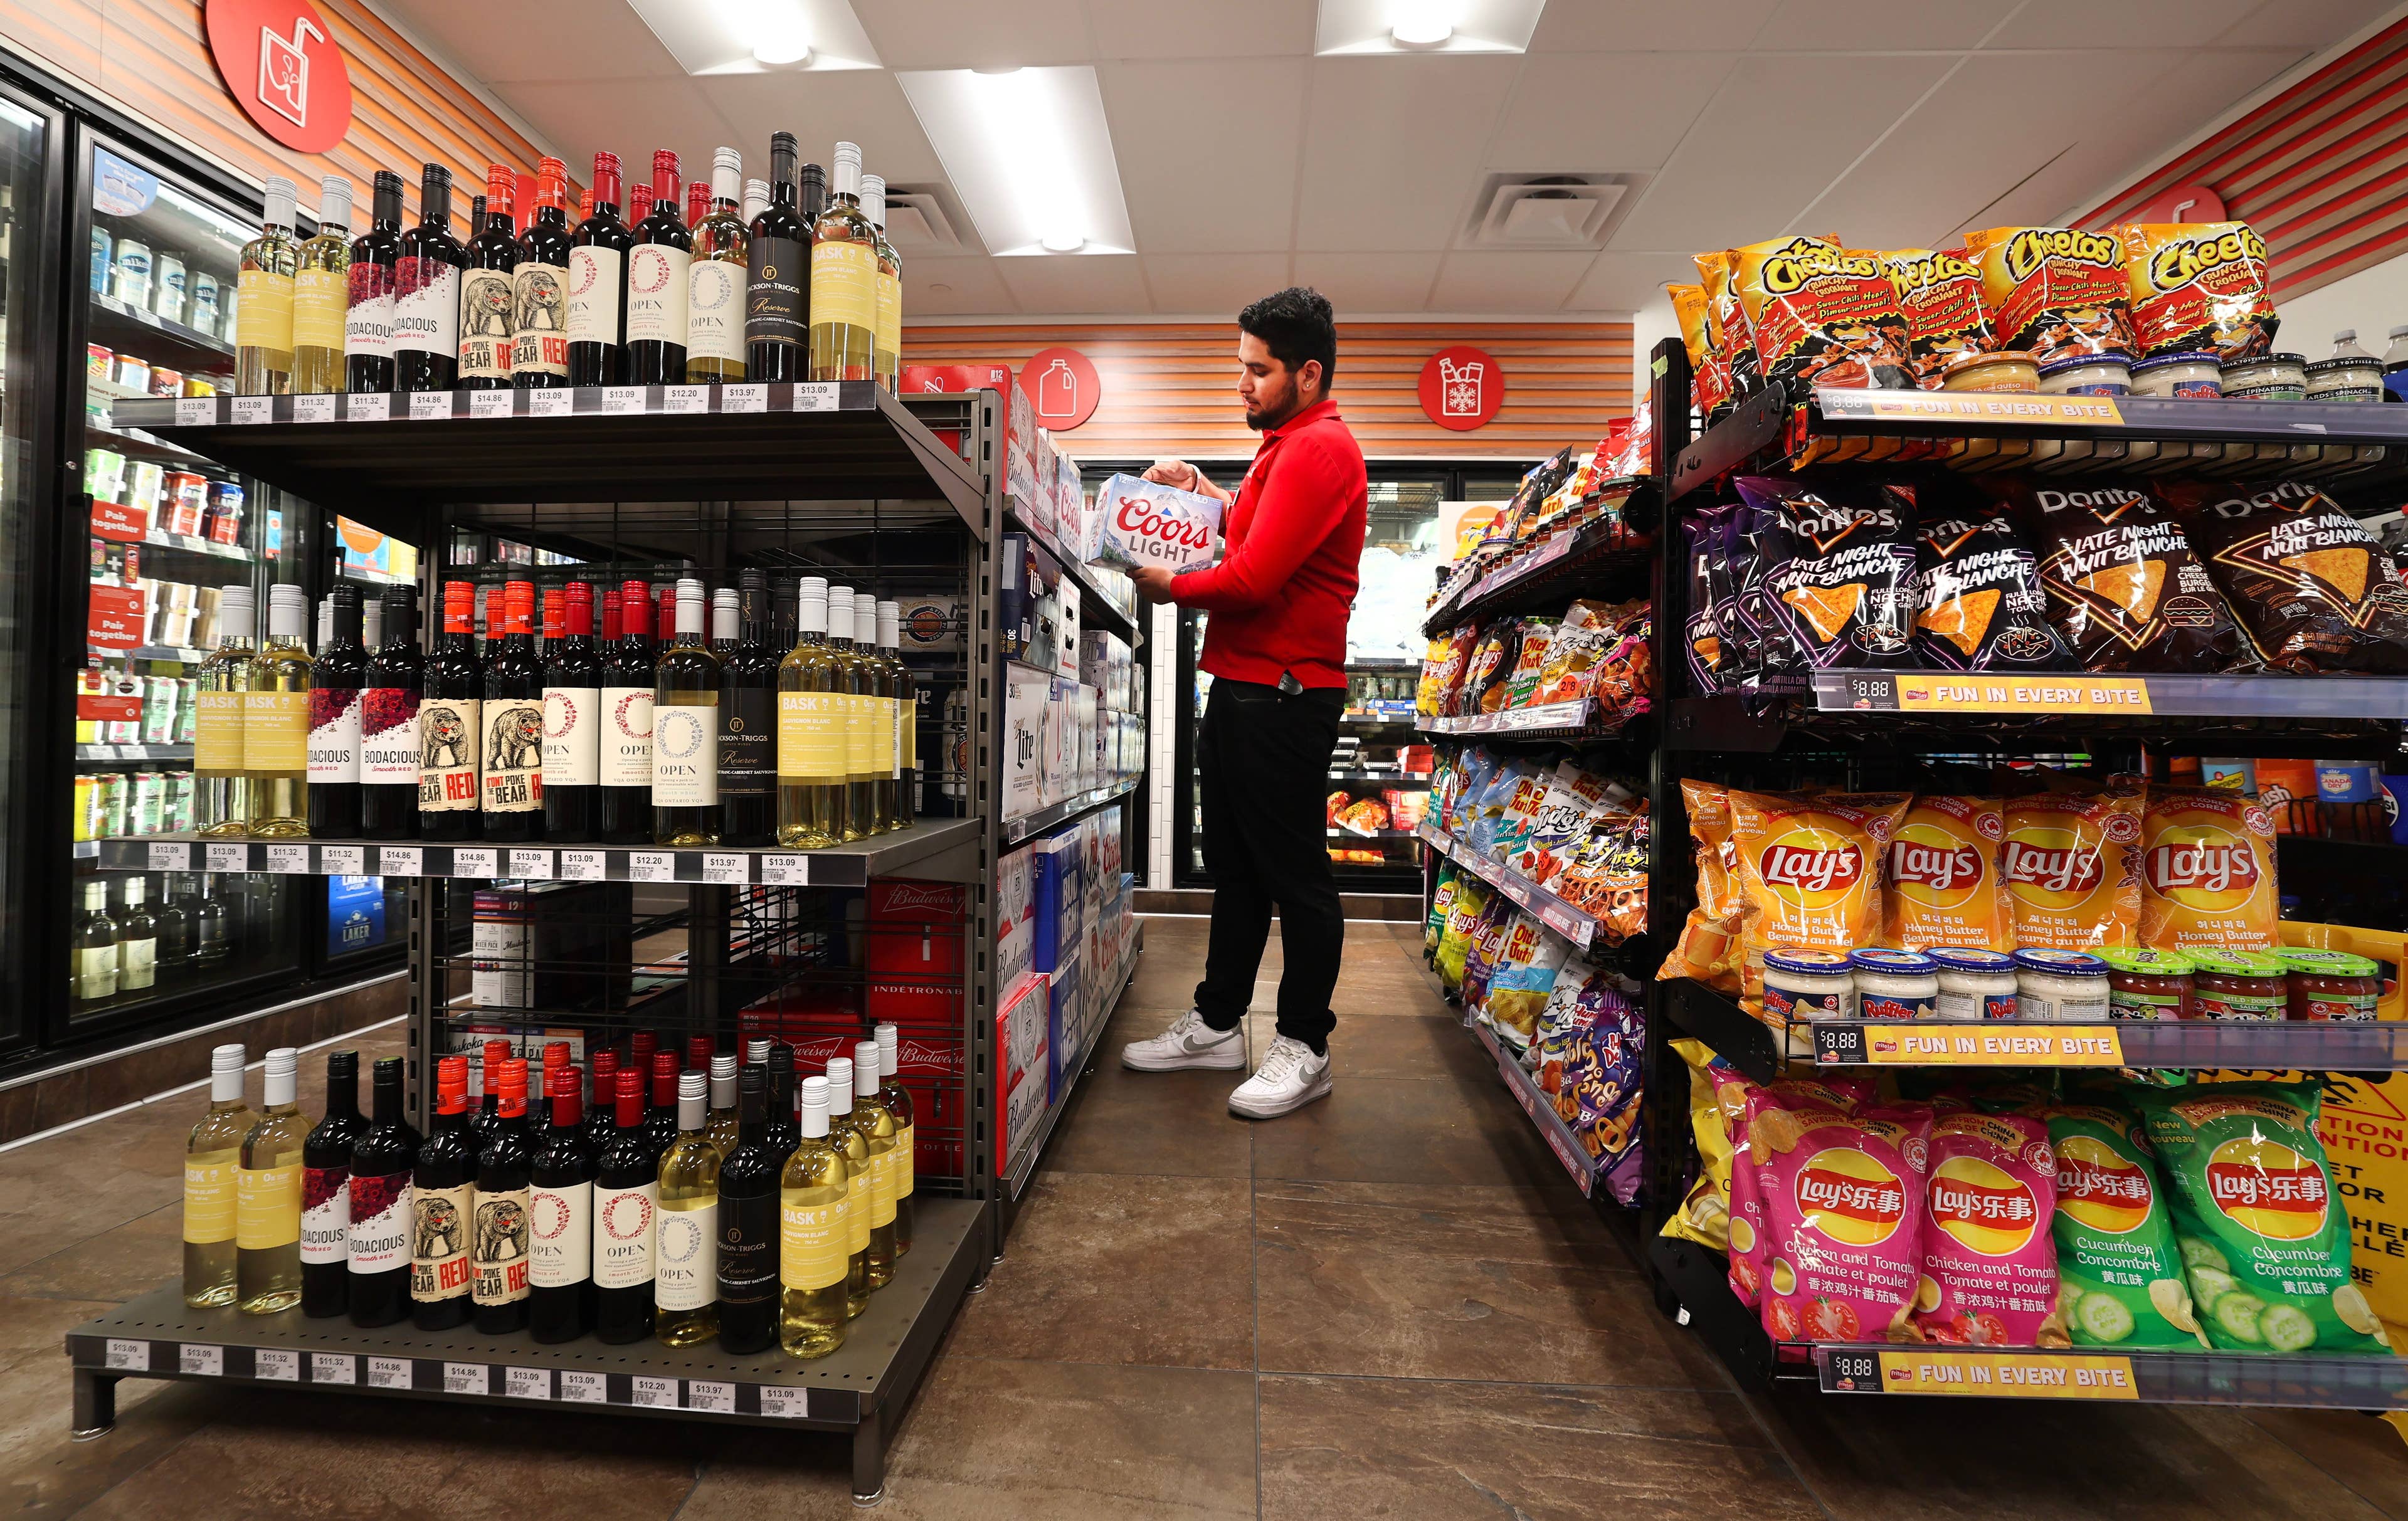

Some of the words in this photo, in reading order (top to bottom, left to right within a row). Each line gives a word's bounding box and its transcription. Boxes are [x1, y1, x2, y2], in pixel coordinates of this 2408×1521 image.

[814, 246, 843, 261] BASK
[2010, 230, 2114, 282] Cheetos
[1764, 251, 1875, 291] Cheetos
[1806, 277, 1848, 292] CRUNCHY
[1815, 284, 1859, 297] CROQUANT
[630, 300, 663, 311] OPEN
[749, 297, 791, 314] Reserve
[691, 316, 724, 328] OPEN
[519, 335, 537, 346] POKE
[513, 345, 539, 364] BEAR
[416, 396, 441, 404] $14.86
[477, 394, 502, 403] $14.86
[537, 392, 562, 400] $13.09
[672, 389, 697, 397] $12.20
[182, 402, 206, 411] $13.09
[238, 401, 261, 409] $13.09
[1911, 401, 1950, 412] FUN
[1961, 402, 1981, 413] IN
[1990, 403, 2054, 416] EVERY
[2063, 404, 2113, 417] BITE
[1186, 493, 1208, 504] COLD
[2037, 488, 2157, 513] Doritos
[104, 509, 129, 521] Pair
[92, 518, 139, 534] together
[1117, 497, 1209, 549] Coors
[2074, 529, 2118, 555] LATE
[2121, 522, 2172, 541] NIGHT
[1129, 535, 1191, 564] LIGHT
[2113, 536, 2189, 561] BLANCHE
[1790, 556, 1830, 574] LATE
[1832, 543, 1896, 565] NIGHT
[1820, 558, 1907, 586] BLANCHE
[102, 620, 125, 630] Pair
[89, 629, 137, 642] together
[1523, 638, 1550, 653] Old
[1852, 680, 1889, 697] $8.88
[1936, 687, 1979, 702] FUN
[1987, 687, 2008, 702] IN
[2014, 688, 2082, 703] EVERY
[2090, 688, 2141, 704] BITE
[200, 696, 238, 708] BASK
[245, 697, 276, 708] BASK
[783, 697, 818, 711] BASK
[364, 750, 420, 764] BODACIOUS
[719, 750, 759, 766] Reserve
[660, 765, 696, 776] OPEN
[445, 771, 475, 801] RED
[505, 774, 525, 786] POKE
[495, 785, 527, 804] BEAR
[2195, 796, 2232, 809] KOREA
[460, 853, 485, 861] $14.86
[516, 853, 541, 861] $13.09
[636, 856, 662, 865] $12.20
[710, 858, 736, 866] $13.97
[769, 858, 795, 866] $13.09
[1767, 846, 1856, 892] Lay's
[1893, 841, 1975, 890] Lay's
[2007, 841, 2094, 892] Lay's
[2157, 843, 2251, 892] Lay's
[342, 925, 370, 942] LAKER
[1514, 924, 1534, 945] Old
[1904, 923, 1943, 936] Honey
[1945, 924, 1983, 935] Butter
[2177, 930, 2226, 943] Honey
[2227, 930, 2266, 941] Butter
[1902, 933, 1945, 944] Beurre
[1946, 935, 1962, 944] au
[1964, 935, 1990, 946] miel
[2123, 992, 2150, 1002] DOUCE
[1821, 1031, 1857, 1048] $8.88
[1904, 1037, 1948, 1053] FUN
[1956, 1038, 1977, 1053] IN
[1985, 1038, 2052, 1054] EVERY
[2061, 1038, 2113, 1055] BITE
[2261, 1101, 2298, 1116] CHINA
[1987, 1121, 2016, 1140] CHINA
[2152, 1121, 2181, 1130] New
[1980, 1127, 2010, 1145] CHINE
[1800, 1177, 1854, 1209] Lay's
[2214, 1172, 2271, 1204] Lay's
[1935, 1186, 1982, 1219] Lay's
[783, 1208, 815, 1225] BASK
[349, 1233, 404, 1253] BODACIOUS
[607, 1242, 645, 1258] OPEN
[2076, 1236, 2153, 1255] Cucumber
[1785, 1240, 1838, 1261] Chicken
[1842, 1251, 1869, 1266] and
[1872, 1255, 1914, 1274] Tomato
[2252, 1246, 2330, 1261] Cucumber
[1926, 1255, 1980, 1273] Chicken
[1983, 1263, 2010, 1276] and
[2014, 1264, 2056, 1279] Tomato
[2076, 1252, 2162, 1271] Concombre
[411, 1275, 435, 1292] BEAR
[440, 1256, 469, 1290] RED
[418, 1264, 433, 1276] POKE
[660, 1268, 695, 1280] OPEN
[2254, 1262, 2343, 1278] Concombre
[1867, 1271, 1908, 1289] poulet
[1941, 1271, 1993, 1290] Tomate
[1996, 1279, 2009, 1291] et
[2013, 1280, 2051, 1298] poulet
[2101, 1270, 2145, 1287] 黄瓜味
[2283, 1280, 2329, 1295] 黄瓜味
[319, 1357, 344, 1366] $11.32
[375, 1362, 401, 1372] $14.86
[1836, 1357, 1872, 1376] $8.88
[451, 1367, 477, 1377] $14.86
[514, 1371, 539, 1381] $13.09
[568, 1375, 595, 1384] $13.09
[1920, 1365, 1964, 1384] FUN
[1971, 1366, 1992, 1384] IN
[1999, 1367, 2067, 1386] EVERY
[2075, 1368, 2128, 1387] BITE
[639, 1381, 665, 1391] $12.20
[695, 1385, 722, 1394] $13.97
[767, 1389, 794, 1399] $13.09
